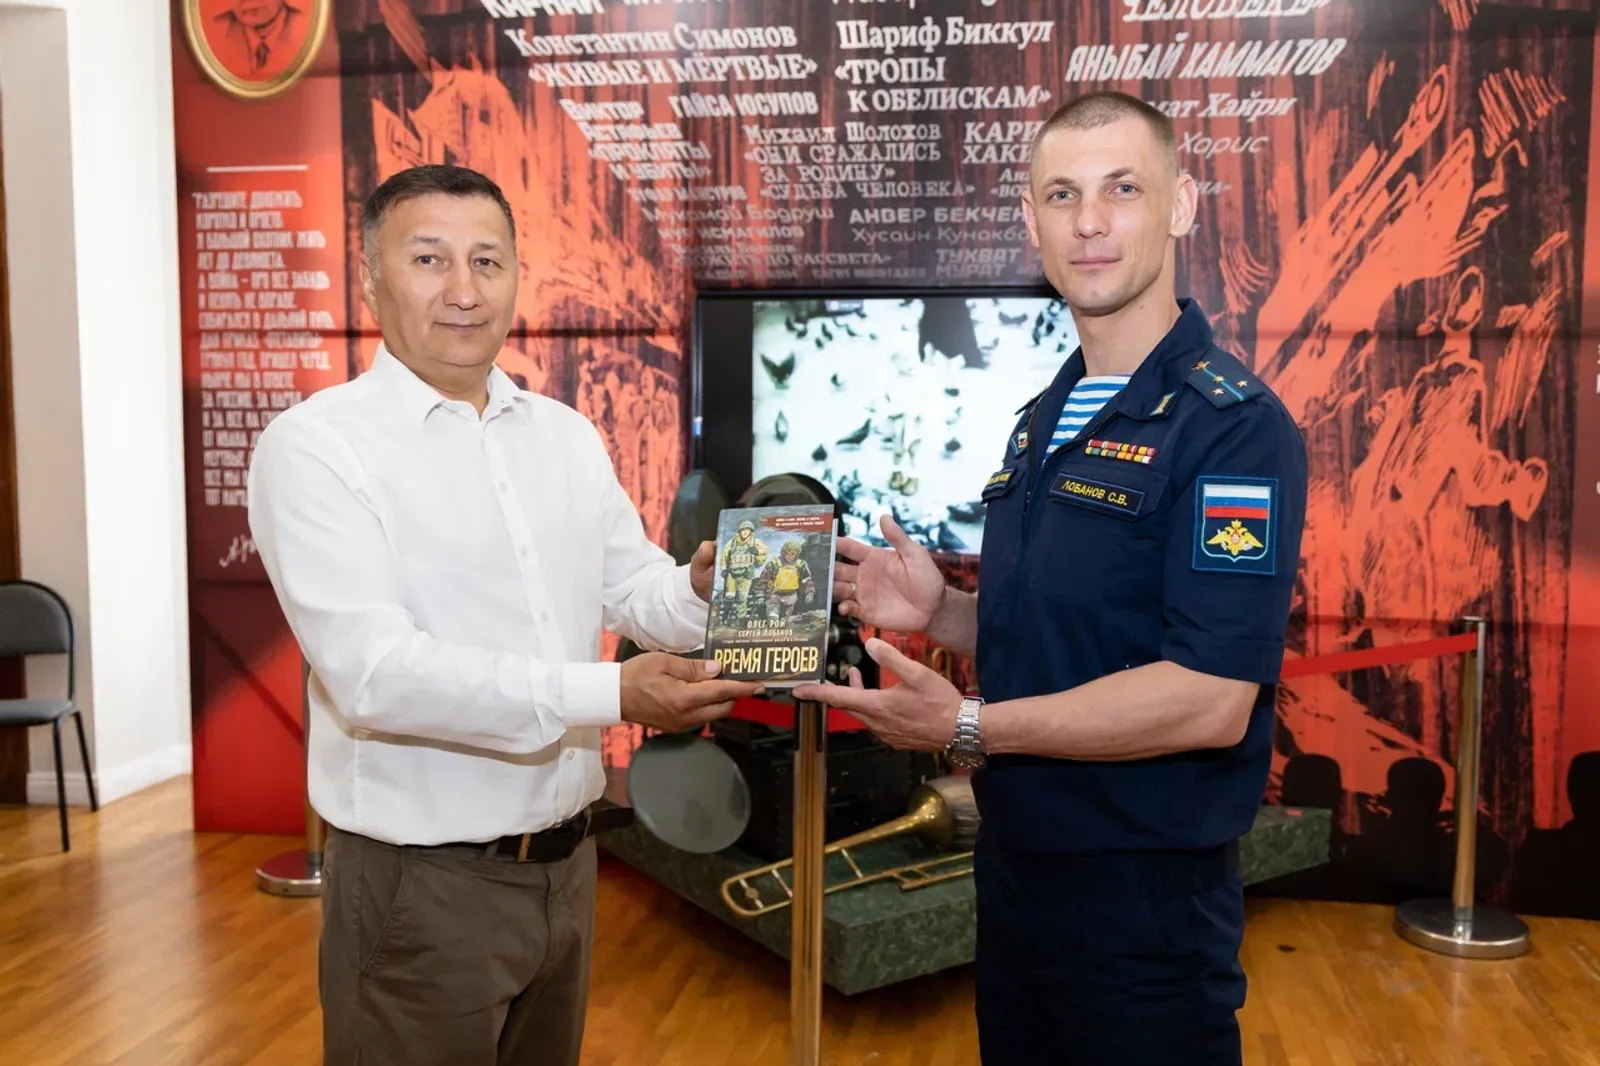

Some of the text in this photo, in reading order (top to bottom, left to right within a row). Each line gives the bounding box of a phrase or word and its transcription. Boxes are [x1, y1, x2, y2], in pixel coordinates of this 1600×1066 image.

[503, 22, 797, 56] Константин Симонов
[836, 16, 1055, 54] Шариф Биккул
[1065, 32, 1347, 82] ЯНЫБАЙ ХАММАТОВ
[528, 59, 648, 87] «ЖИВЫЕ
[645, 58, 673, 84] И
[835, 57, 947, 85] «ТРОПЫ
[733, 91, 820, 118] ЮСУПОВ
[847, 84, 1052, 113] К ОБЕЛИСКАМ»
[1196, 90, 1298, 123] Хайри
[743, 122, 942, 145] Михаил Шолохов
[963, 121, 1045, 144] КАРИ
[808, 143, 942, 164] СРАЖАЛИСЬ
[961, 143, 1032, 165] ХАКИ
[760, 164, 896, 184] ЗА РОДИНУ»
[855, 181, 975, 199] ЧЕЛОВЕКА»
[849, 206, 1026, 224] АНВЕР БЕКЧЕН
[1061, 480, 1128, 506] ЛОБАНОВ С.В.
[769, 617, 786, 628] РОЙ
[764, 646, 819, 673] ГЕРОЕВ
